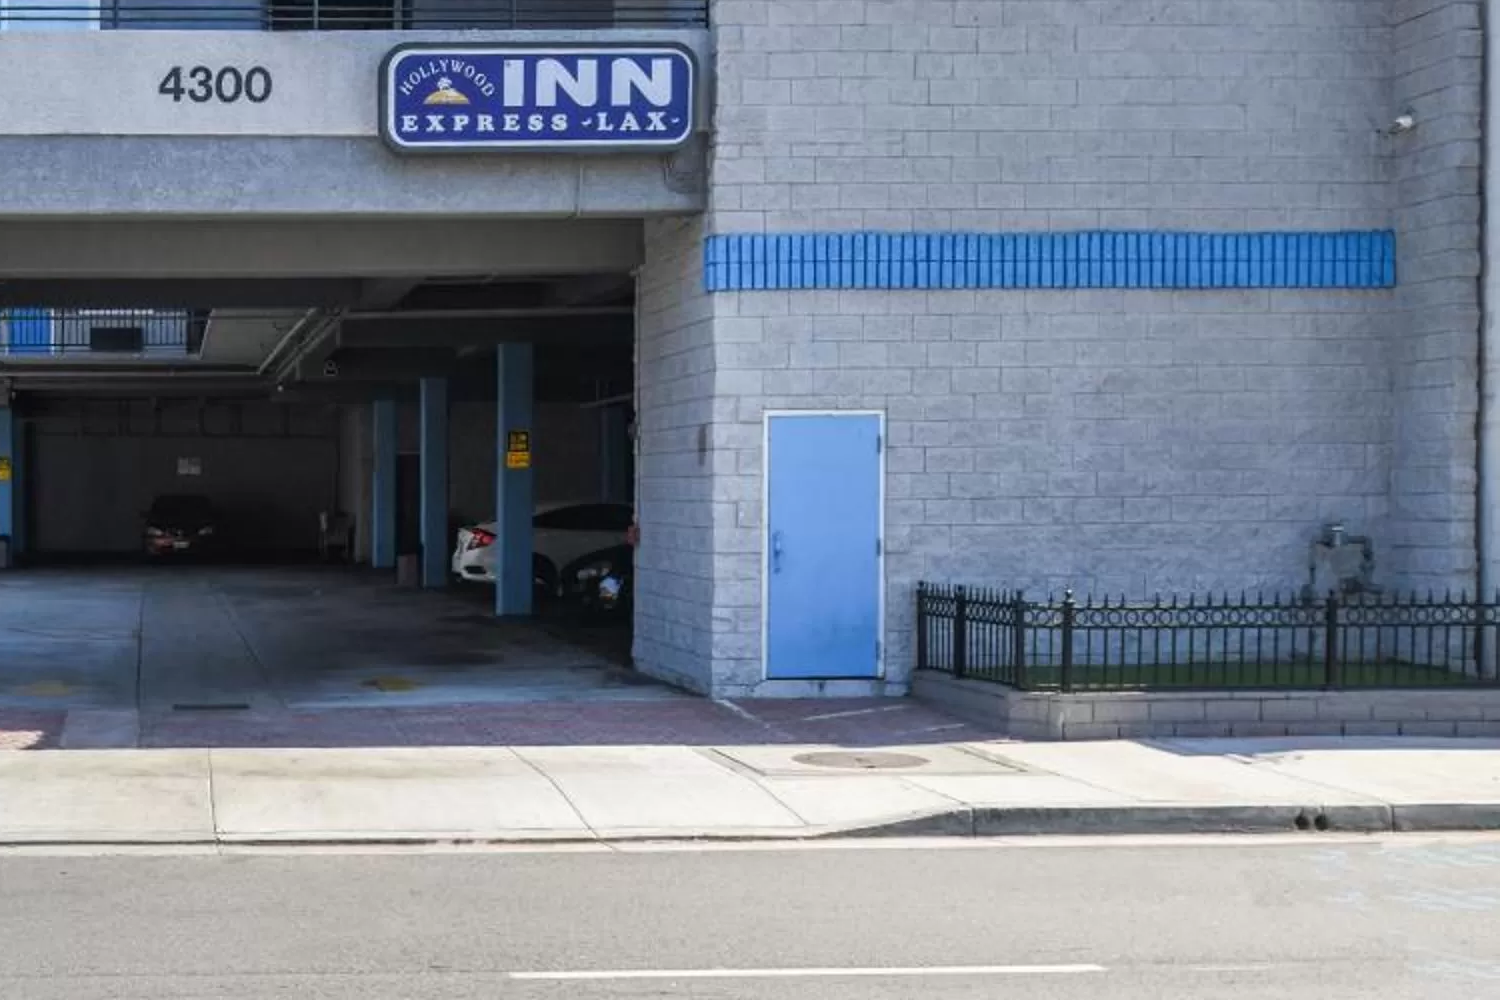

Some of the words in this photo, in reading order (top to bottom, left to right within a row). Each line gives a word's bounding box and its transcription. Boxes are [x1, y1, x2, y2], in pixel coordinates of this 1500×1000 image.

[159, 65, 272, 102] 4300
[399, 59, 495, 97] HOLLYWOOD
[503, 57, 672, 107] INN
[401, 113, 568, 132] EXPRESS
